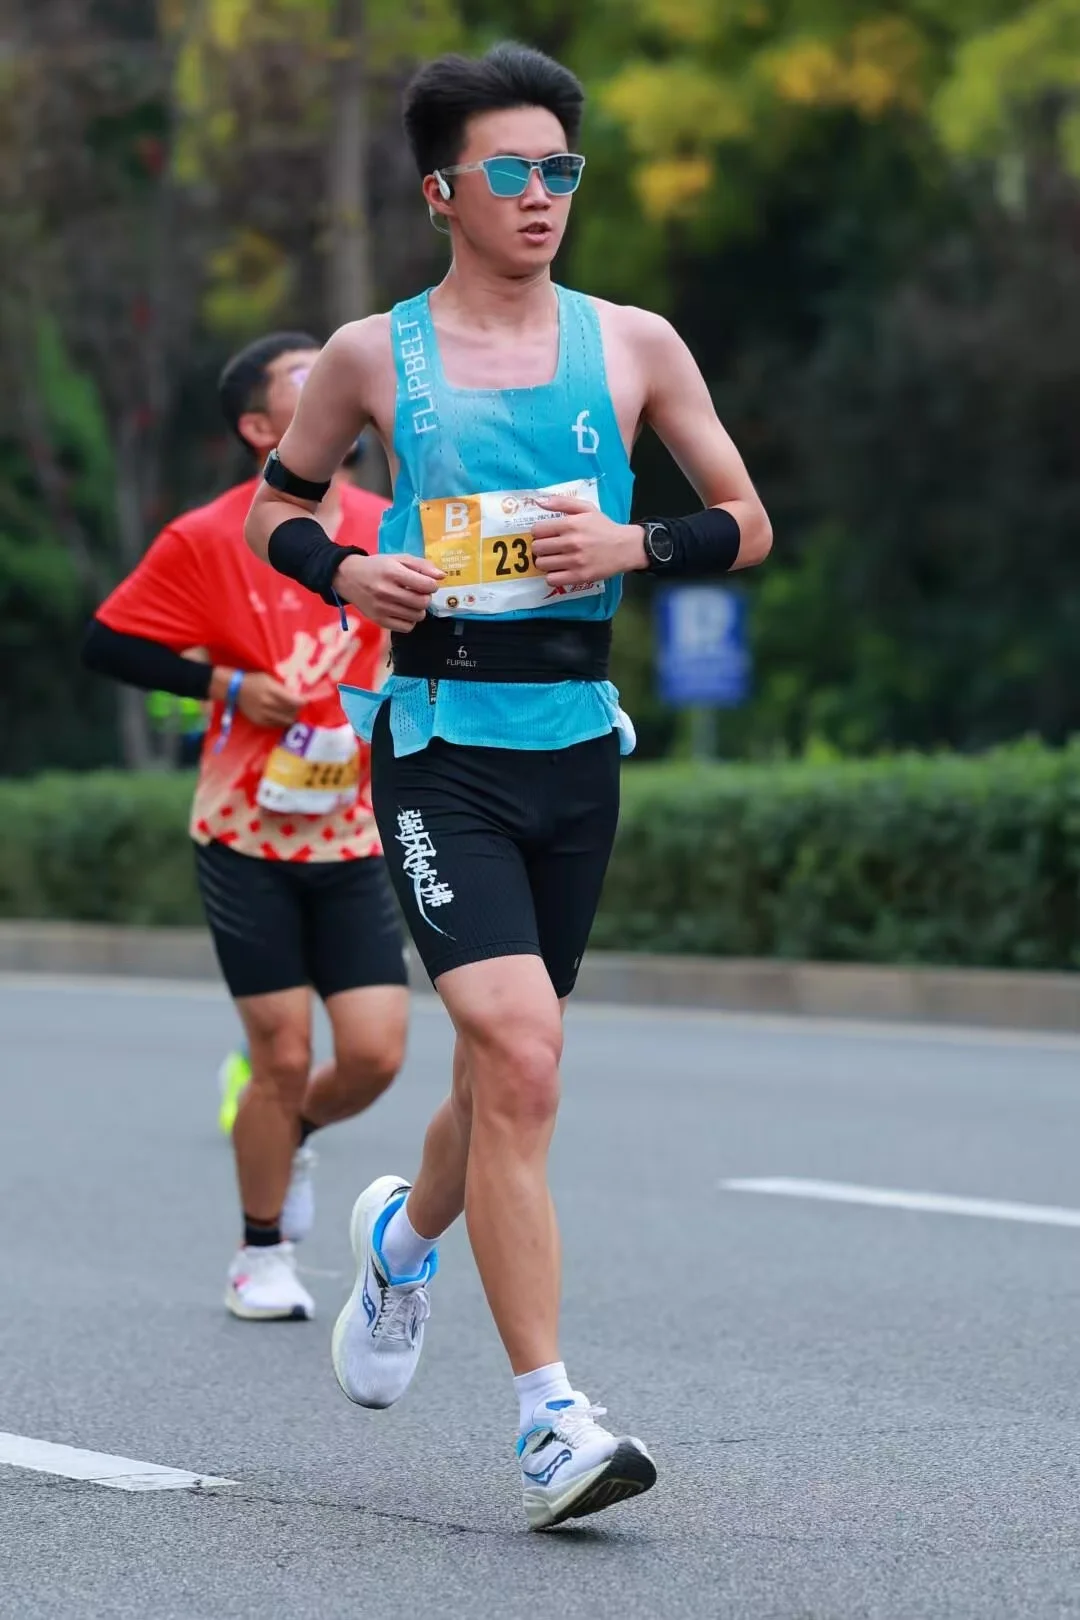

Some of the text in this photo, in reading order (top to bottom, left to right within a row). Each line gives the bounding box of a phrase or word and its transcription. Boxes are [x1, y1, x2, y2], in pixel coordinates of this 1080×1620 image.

[397, 320, 437, 434] FLIPBELT
[445, 503, 469, 533] B
[446, 658, 478, 668] FLIPBELT
[286, 723, 309, 748] C
